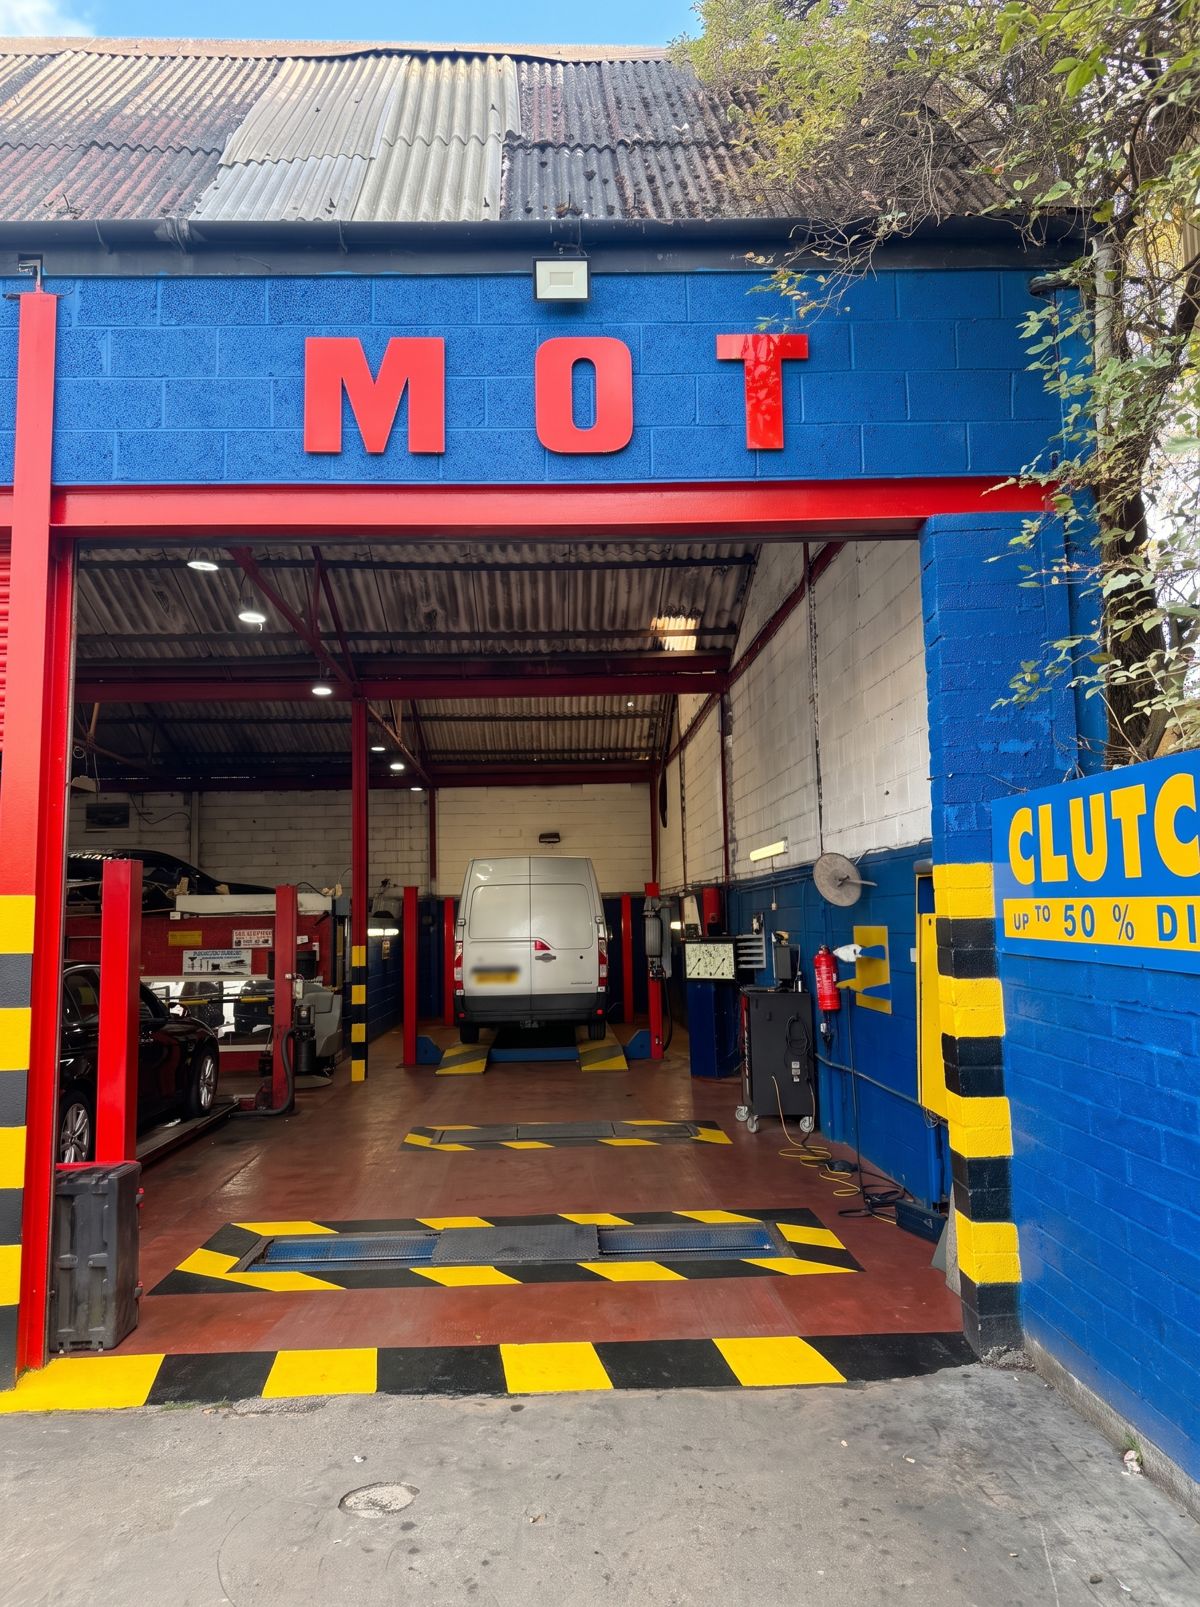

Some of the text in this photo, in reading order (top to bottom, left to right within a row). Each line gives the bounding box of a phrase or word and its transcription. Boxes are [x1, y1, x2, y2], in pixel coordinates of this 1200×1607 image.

[304, 334, 809, 453] MOT
[1009, 773, 1200, 885] CLUTC
[1014, 904, 1197, 943] UP TO 50 % DI
